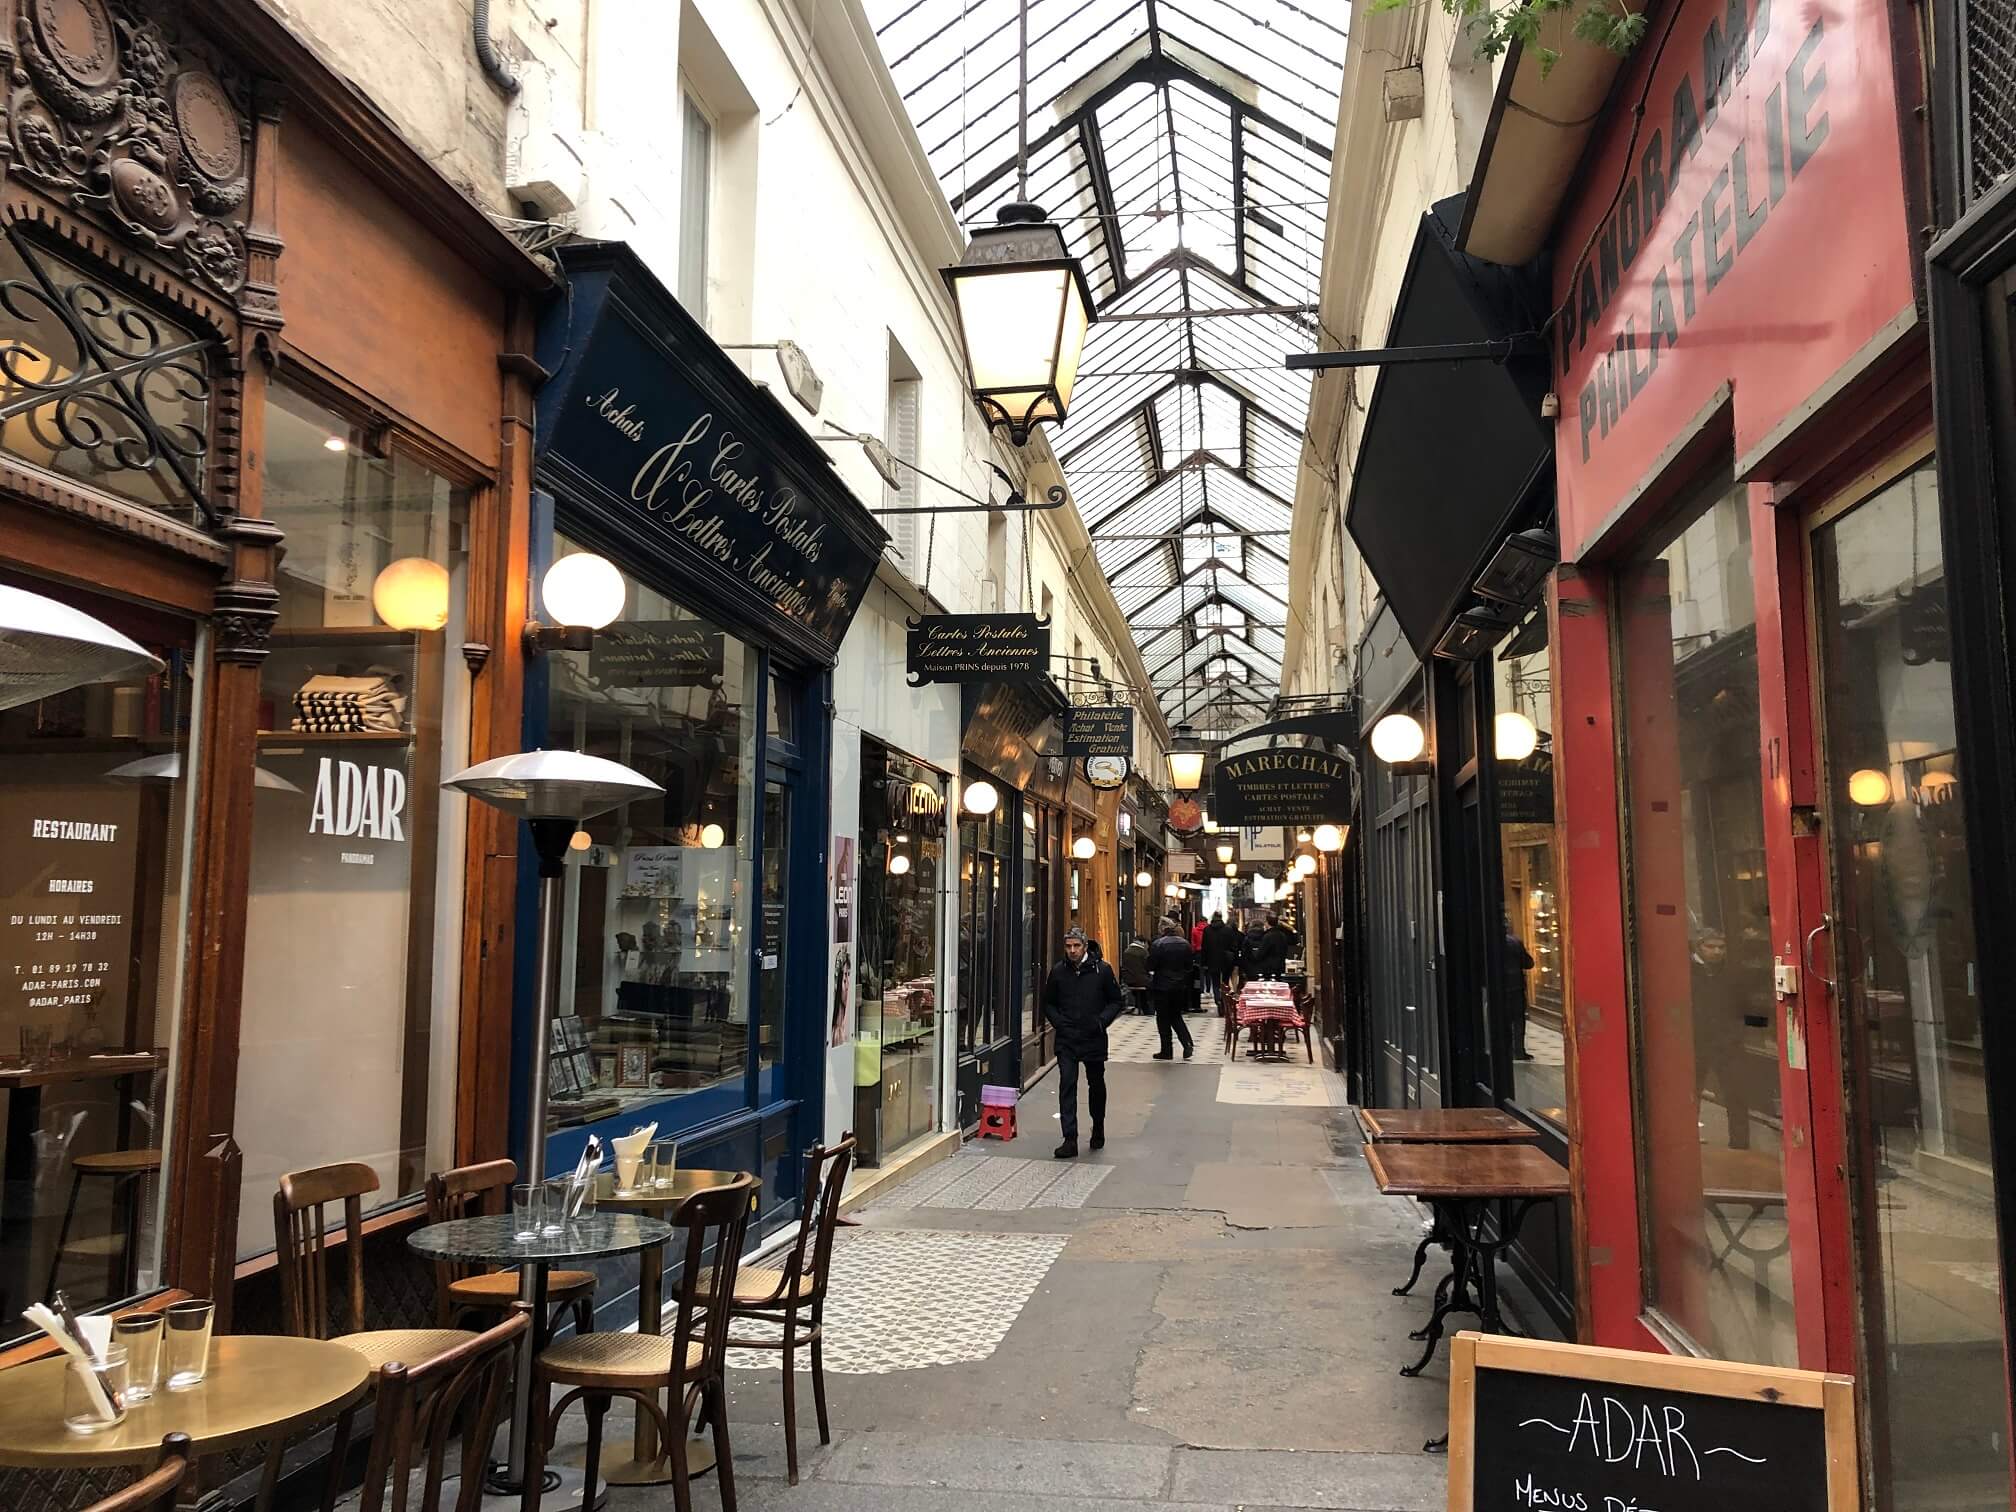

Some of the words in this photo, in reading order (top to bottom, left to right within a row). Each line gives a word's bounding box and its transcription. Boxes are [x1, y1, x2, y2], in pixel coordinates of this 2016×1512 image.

[1579, 16, 1831, 464] PHILATELIE
[586, 387, 643, 443] Achats
[709, 431, 763, 513] Cartes
[762, 487, 827, 563] Postales
[663, 479, 736, 563] Lettres
[928, 625, 967, 640] Cartes
[973, 623, 1028, 640] Postales
[916, 641, 963, 657] Lettres
[968, 642, 1039, 657] Anciennes
[923, 663, 952, 672] Maison
[954, 663, 980, 671] PRINS
[981, 662, 1007, 673] depuis
[1009, 662, 1030, 671] 1978
[1067, 733, 1120, 743] Estimation
[1088, 743, 1129, 753] Gratuite
[1225, 750, 1343, 780] MARÉCHAL
[1238, 783, 1275, 791] TIMBRES
[308, 757, 406, 841] ADAR
[1244, 793, 1279, 801] CARTES
[32, 819, 118, 842] RESTAURANT
[49, 879, 94, 893] HORAIRES
[11, 915, 23, 925] DU
[28, 915, 57, 925] LUNDI
[63, 915, 75, 925] AU
[80, 915, 122, 925] VENDREDI
[35, 931, 53, 941] 12H
[69, 931, 97, 941] 14H30
[98, 962, 109, 972] 32
